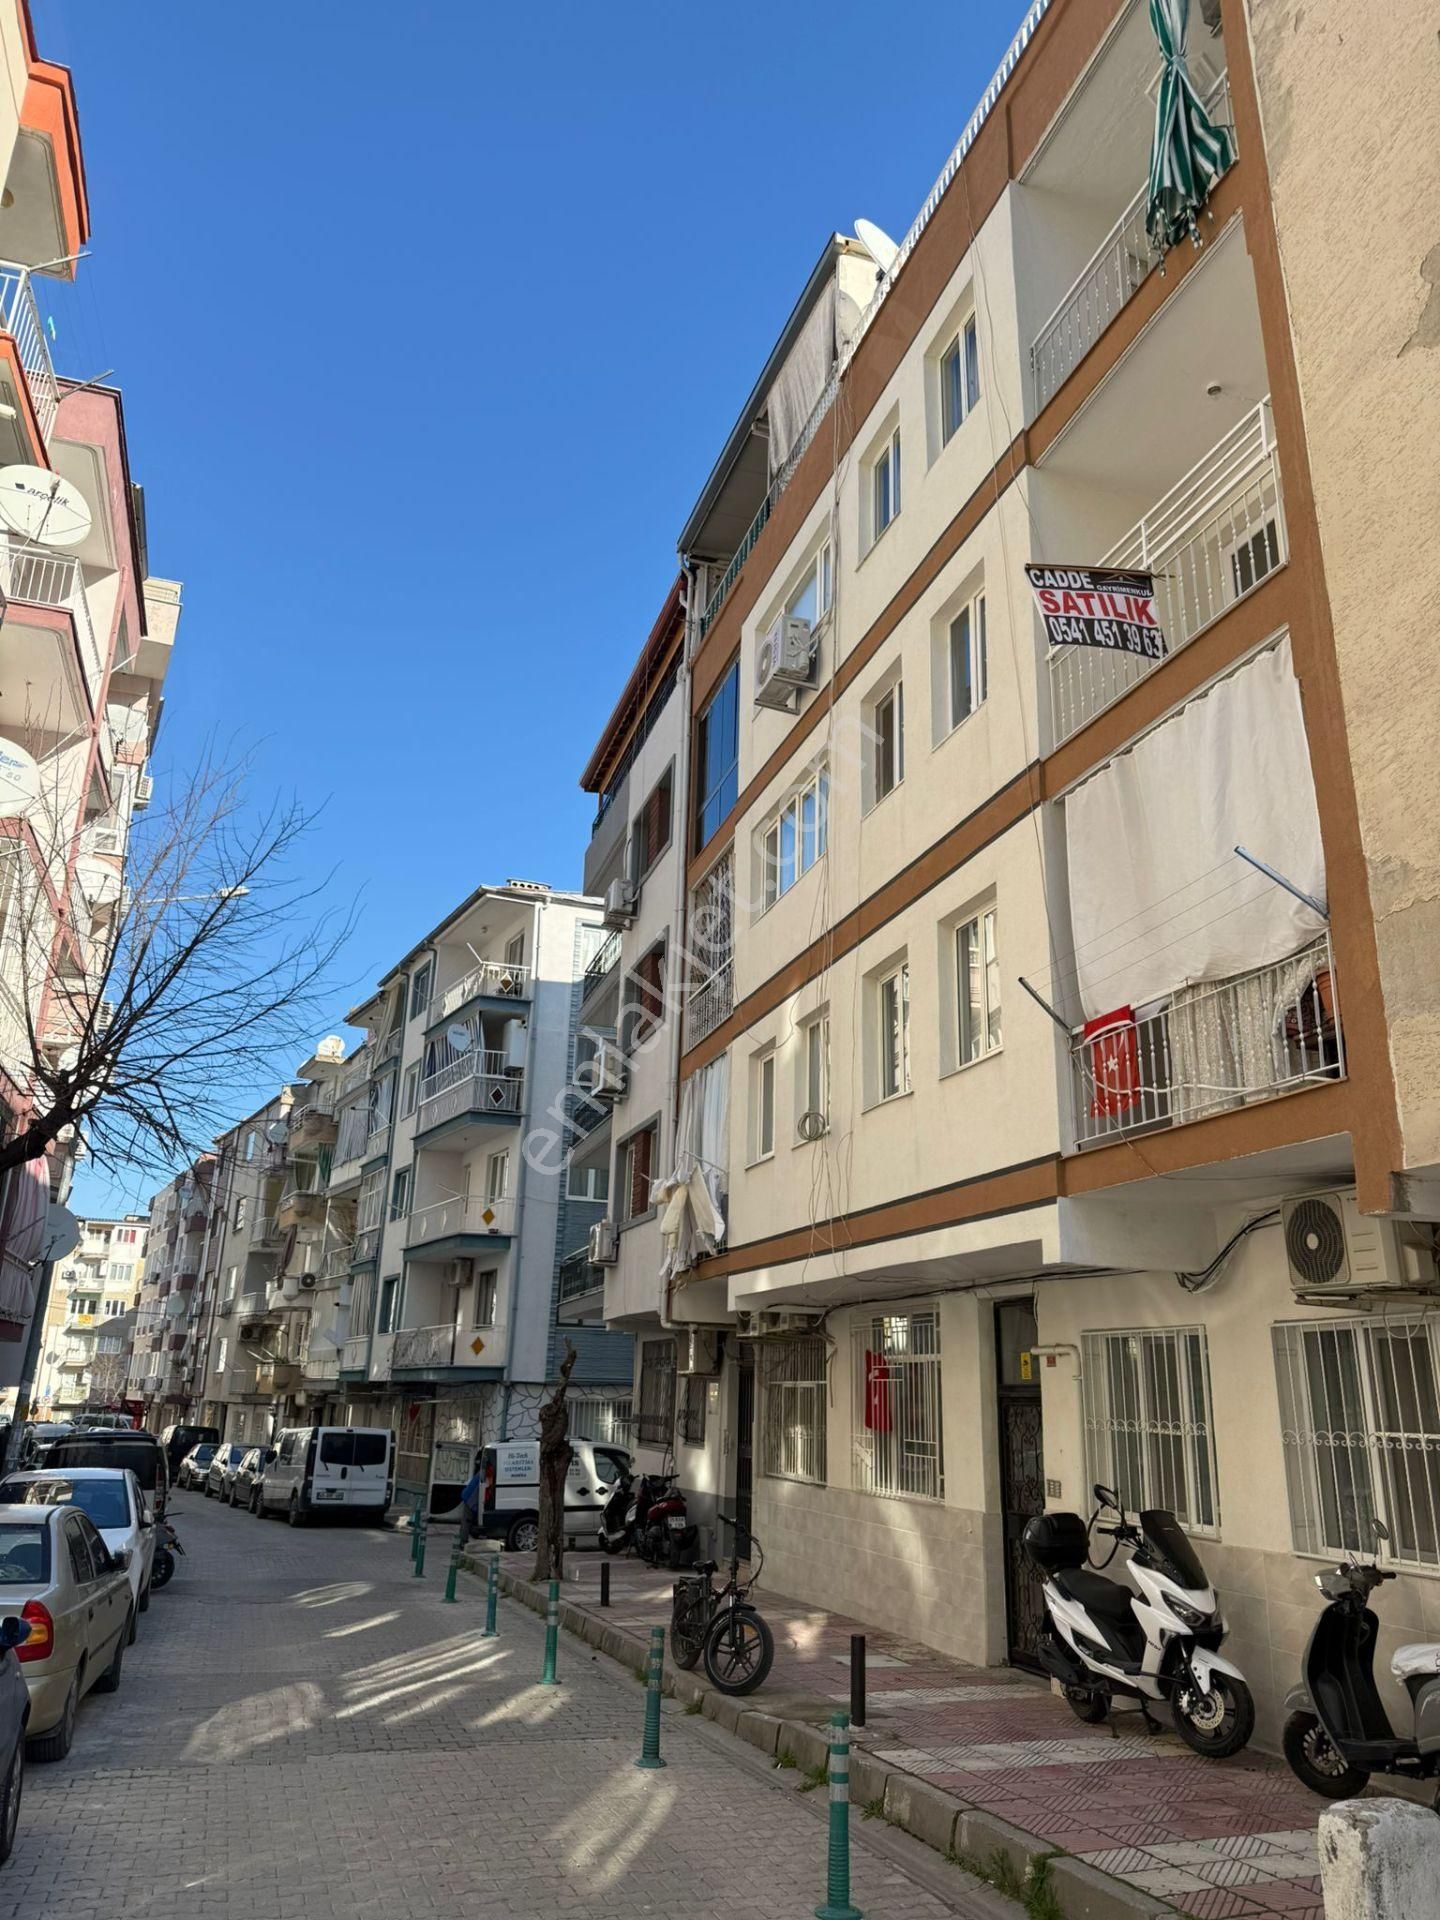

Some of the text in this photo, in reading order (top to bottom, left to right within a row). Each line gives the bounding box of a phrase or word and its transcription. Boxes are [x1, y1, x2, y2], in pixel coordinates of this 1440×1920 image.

[1029, 569, 1095, 589] CADDE
[1038, 589, 1158, 626] SATILIK
[1049, 616, 1092, 644] 0541
[1094, 619, 1123, 648] 451
[1123, 622, 1142, 653] 39
